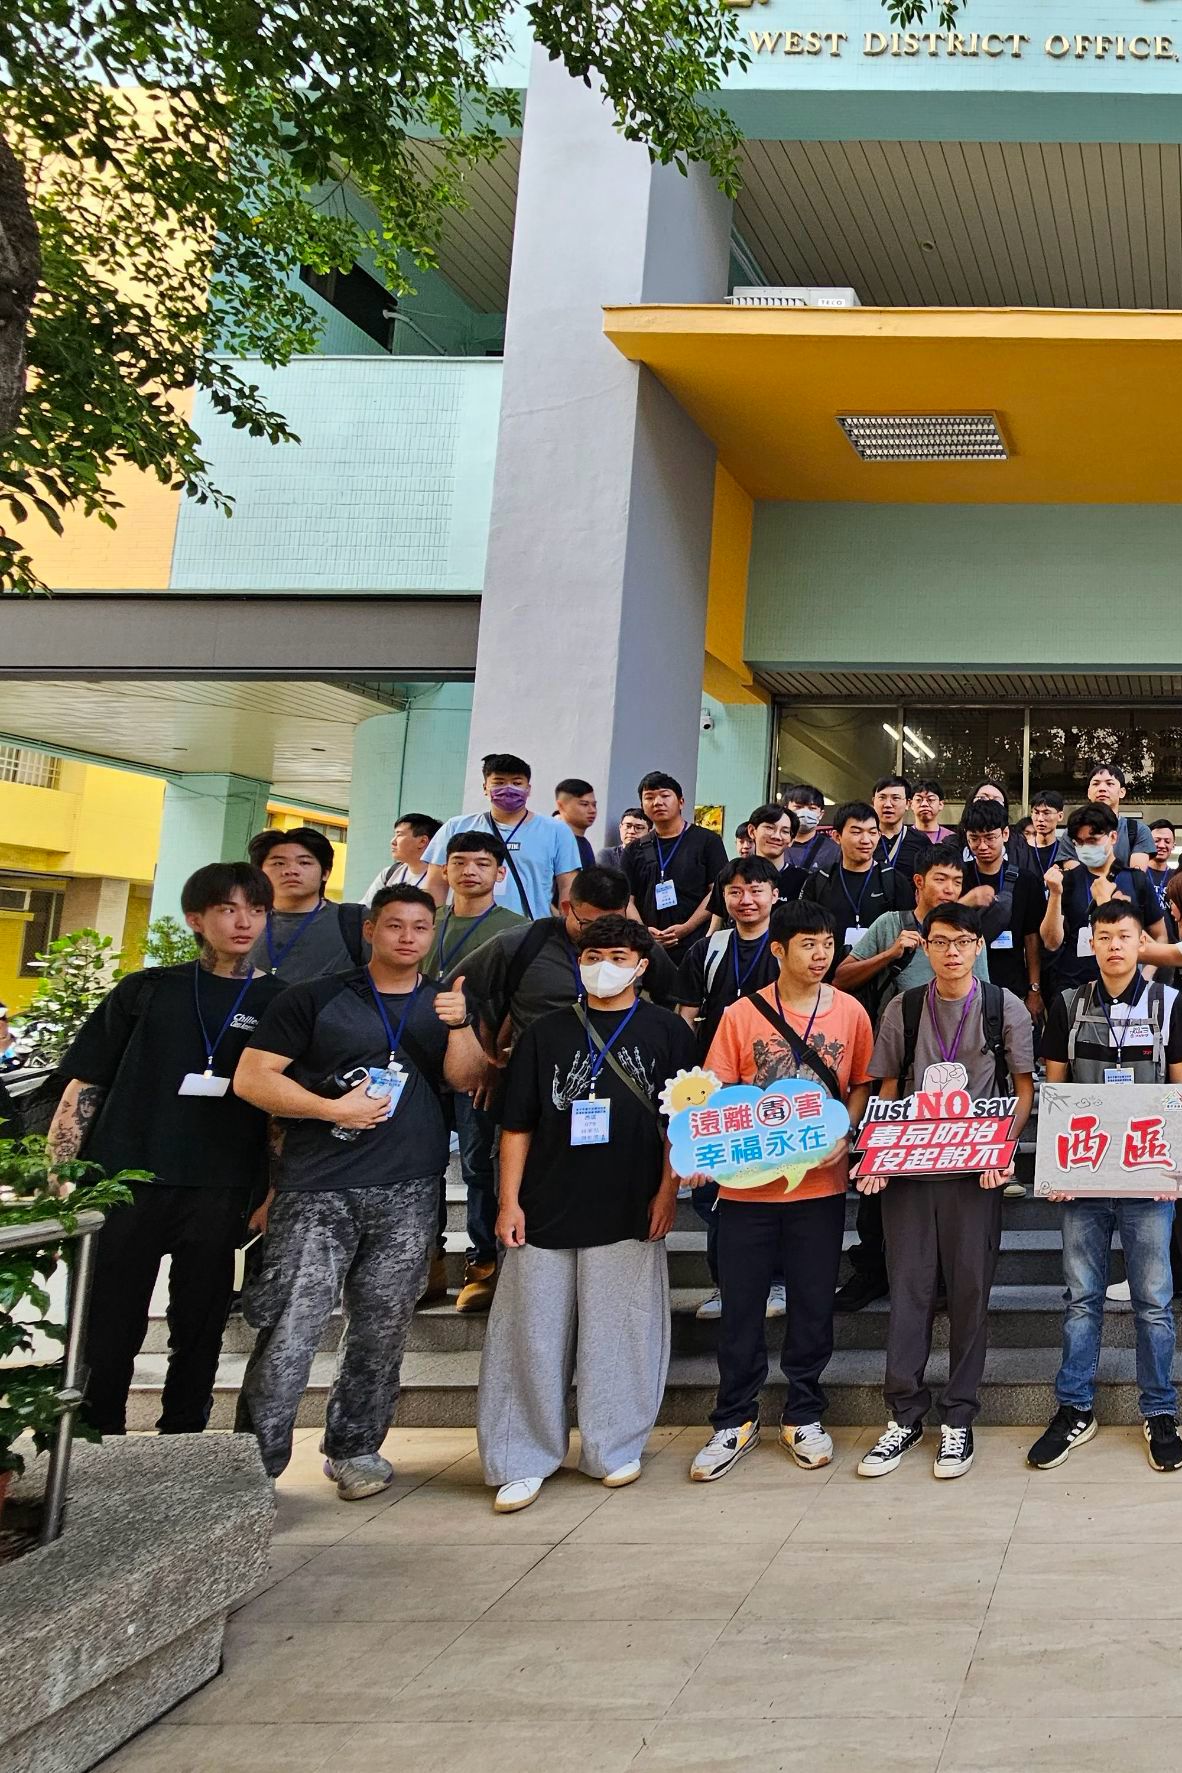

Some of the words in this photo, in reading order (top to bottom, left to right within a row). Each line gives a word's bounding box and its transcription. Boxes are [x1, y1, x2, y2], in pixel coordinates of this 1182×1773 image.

[748, 31, 847, 57] WEST
[863, 31, 1028, 58] DISTRICT
[1045, 34, 1180, 62] OFFICE,
[863, 1098, 912, 1127] just
[915, 1090, 970, 1119] NO
[973, 1097, 1016, 1120] say
[695, 1124, 828, 1170] 幸福永在
[867, 1120, 999, 1148] 毒品防治
[1057, 1115, 1173, 1169] 西區
[870, 1143, 1006, 1172] 役起說不
